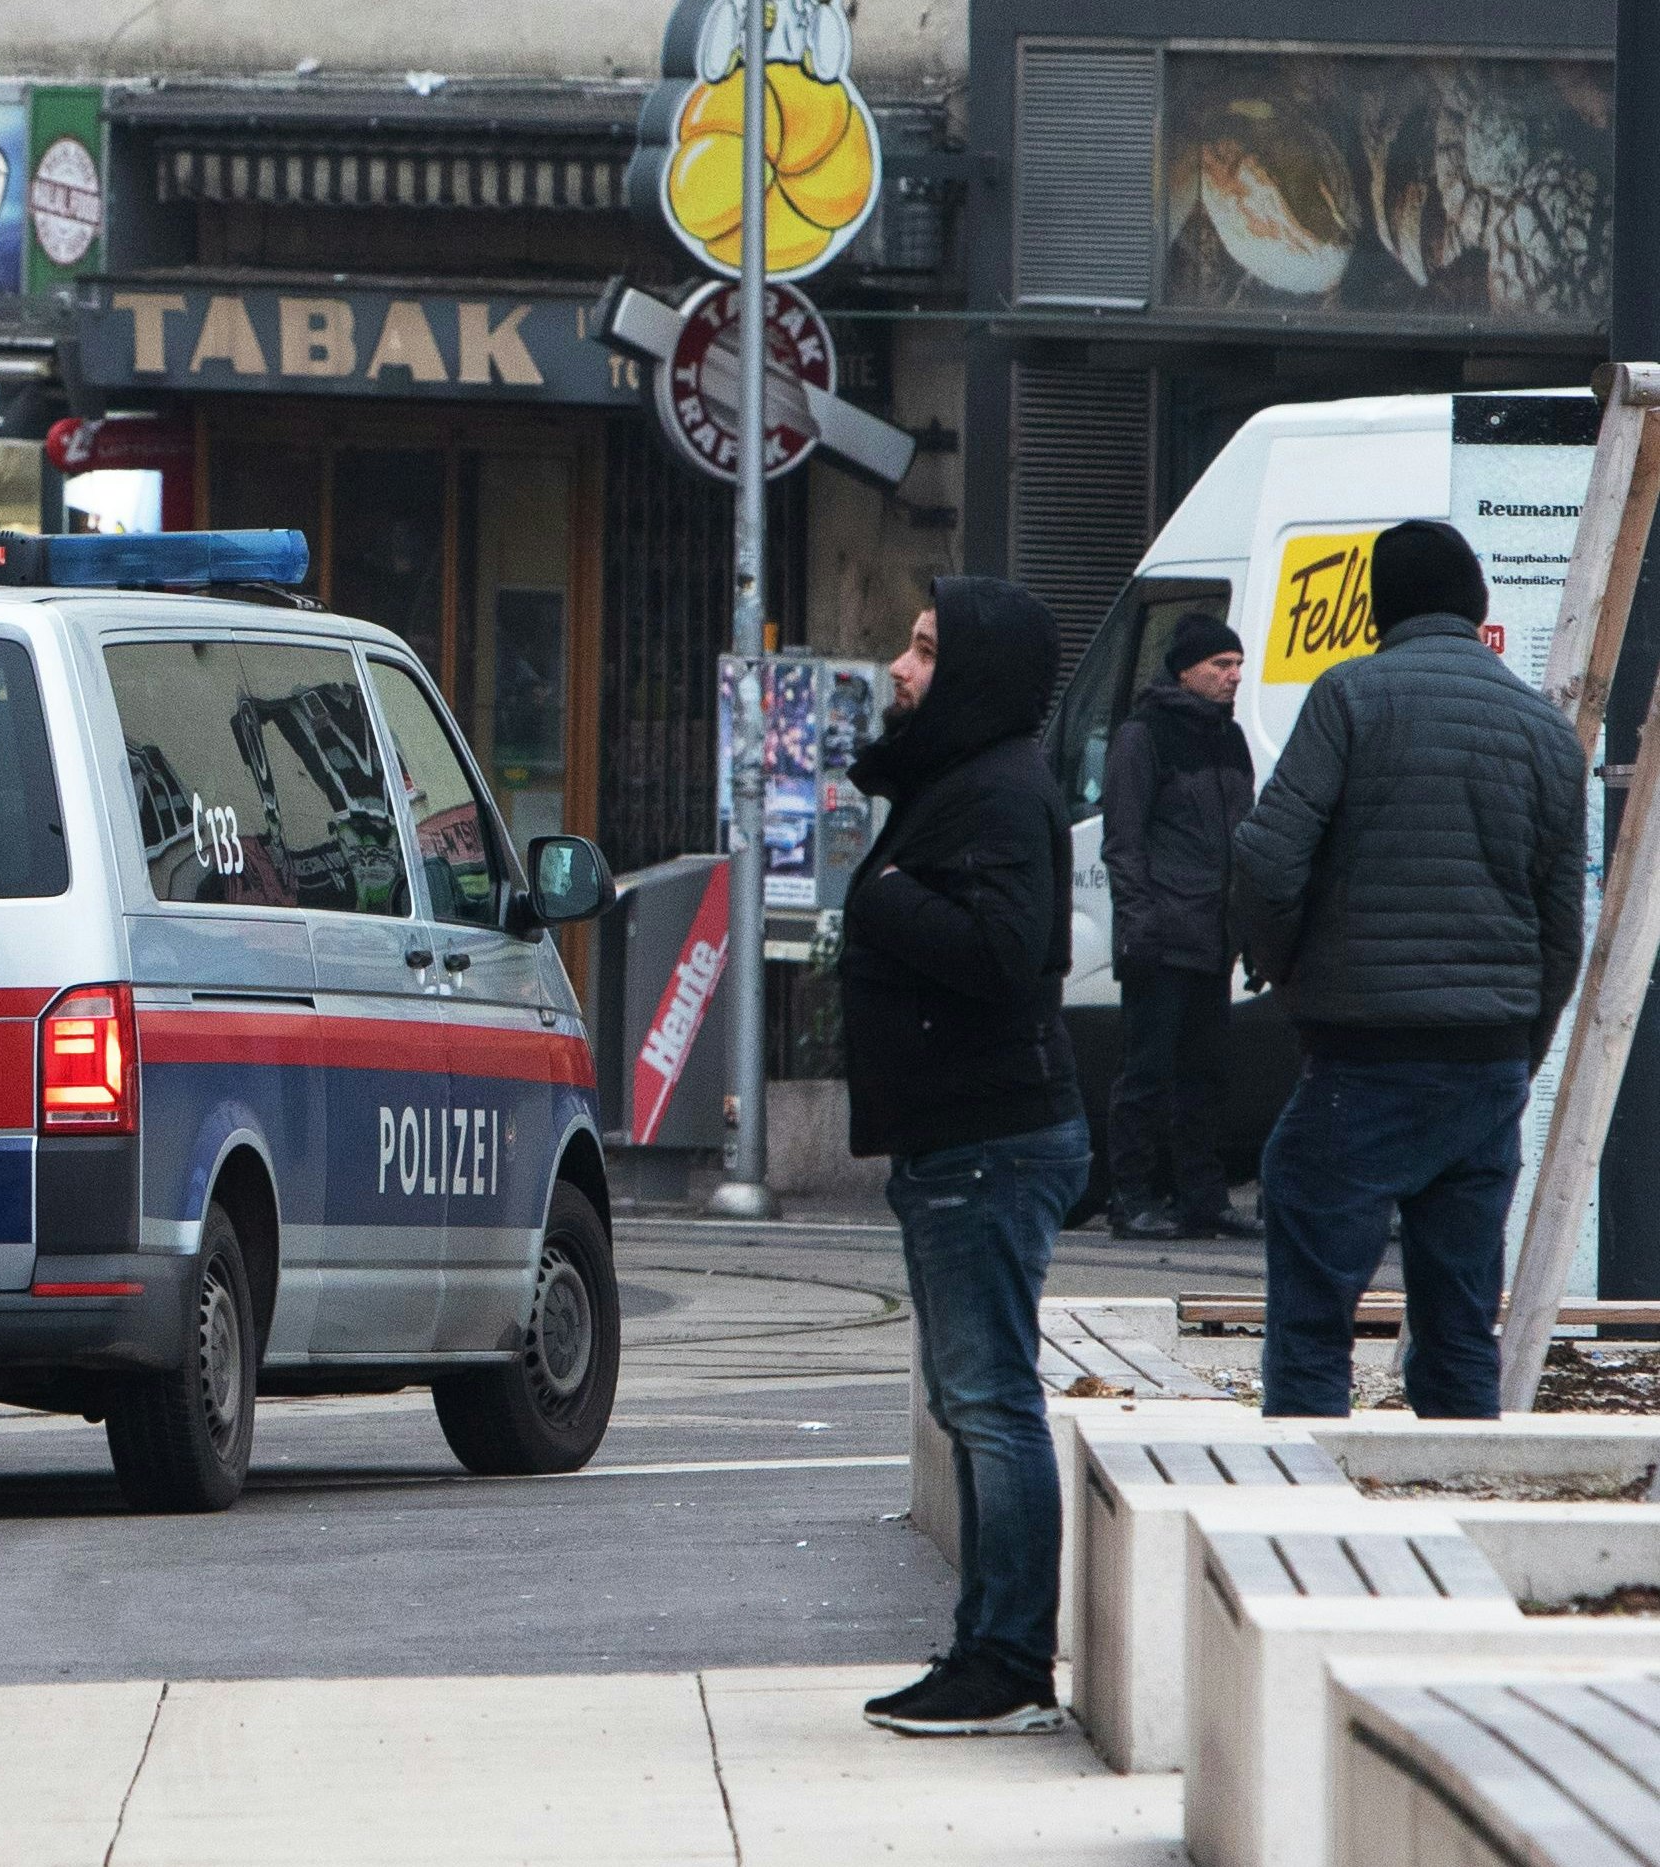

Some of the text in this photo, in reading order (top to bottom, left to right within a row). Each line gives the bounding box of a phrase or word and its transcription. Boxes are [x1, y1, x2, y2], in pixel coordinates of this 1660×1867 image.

[112, 293, 544, 385] TABAK
[1478, 499, 1582, 518] Reumann
[642, 940, 720, 1079] Heute
[378, 1106, 498, 1196] POLIZEI
